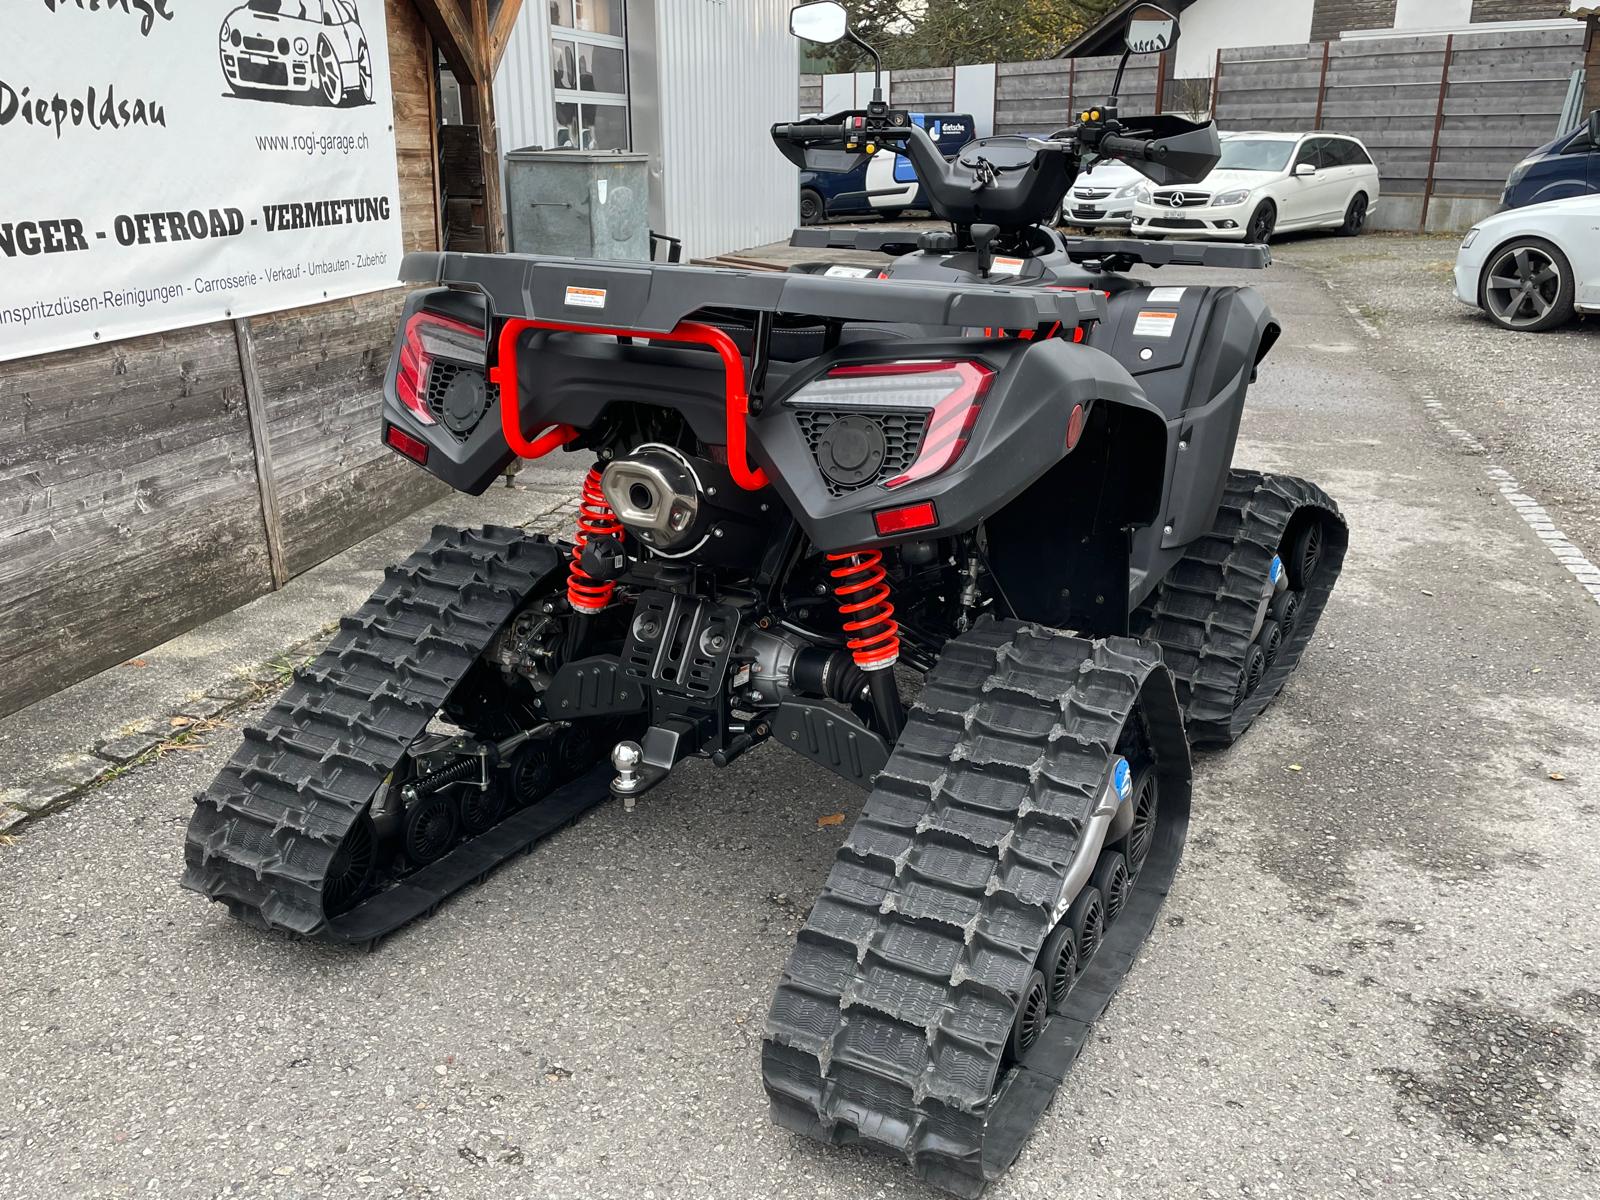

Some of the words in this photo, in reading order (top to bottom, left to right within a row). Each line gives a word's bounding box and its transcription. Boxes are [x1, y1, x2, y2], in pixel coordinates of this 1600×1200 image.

[0, 80, 166, 139] Diepoldsau
[255, 131, 369, 155] www.rogi-garage.ch
[114, 208, 244, 246] OFFROAD
[262, 196, 390, 233] VERMIETUNG
[194, 272, 257, 294] Carrosserie
[265, 263, 301, 283] Verkauf
[308, 258, 350, 276] Umbauten
[356, 251, 388, 268] Zubehör
